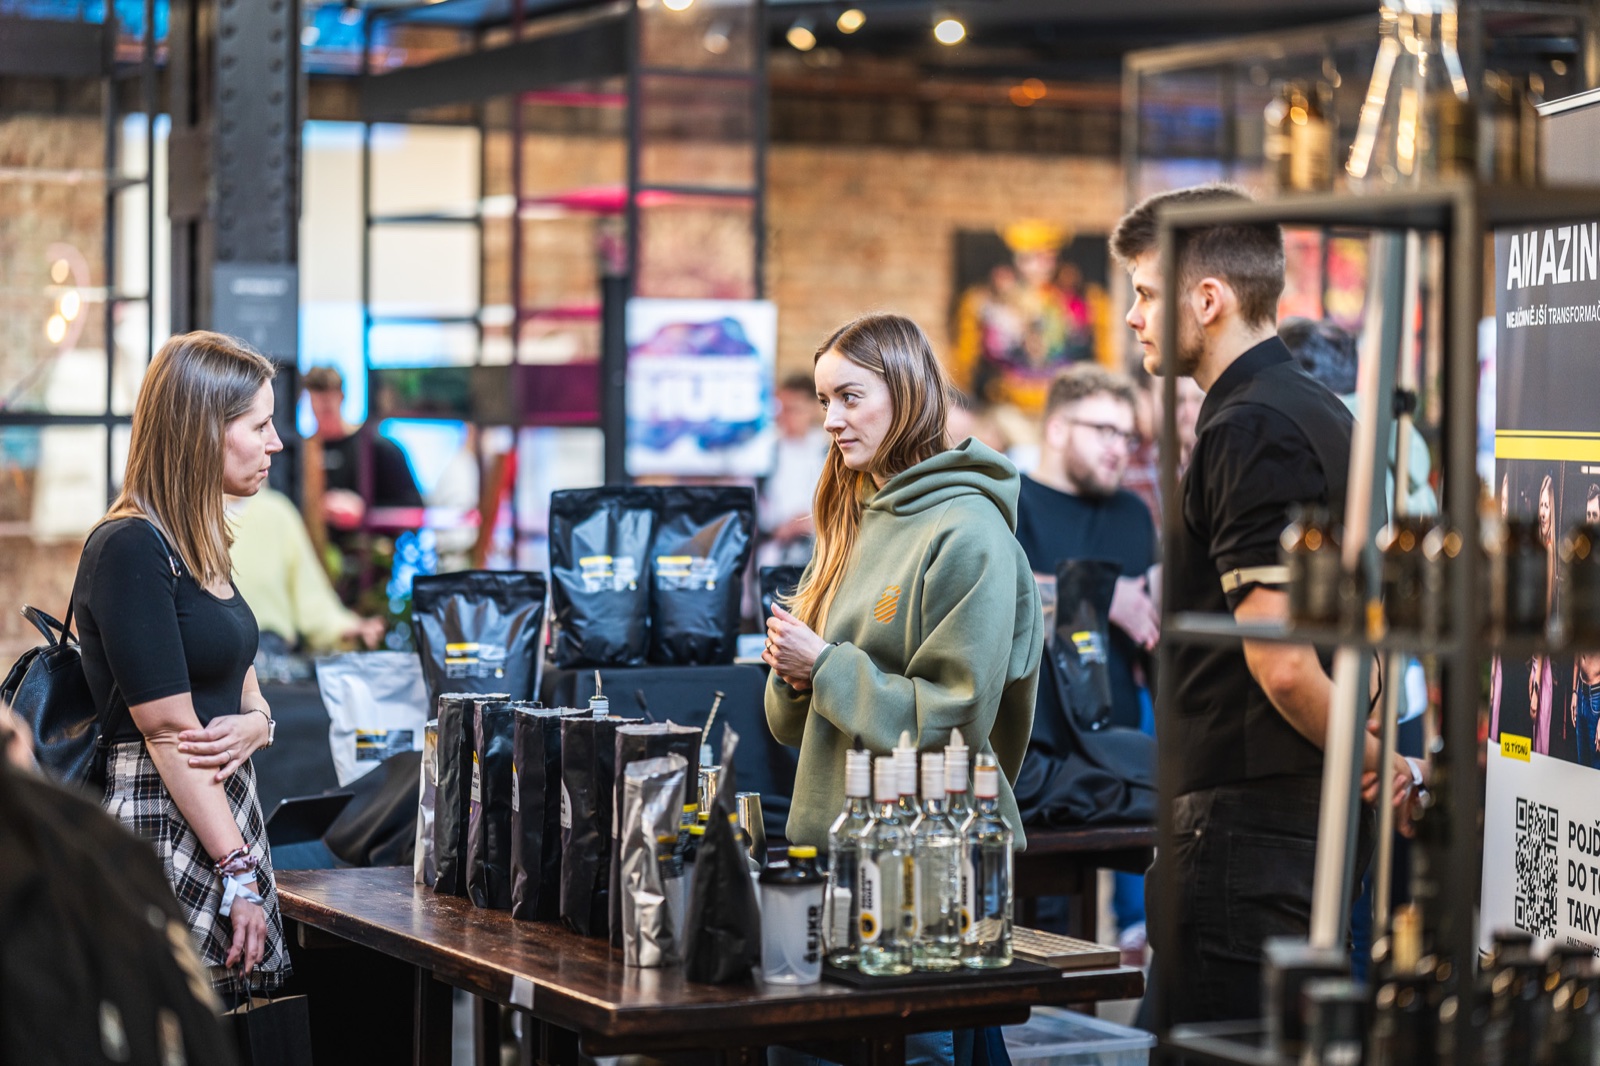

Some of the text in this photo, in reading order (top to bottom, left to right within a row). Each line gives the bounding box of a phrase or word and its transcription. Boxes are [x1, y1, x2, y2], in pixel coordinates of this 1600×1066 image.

[1506, 222, 1600, 290] AMAZIN
[1568, 859, 1600, 896] DO T
[1567, 897, 1600, 936] TAKY
